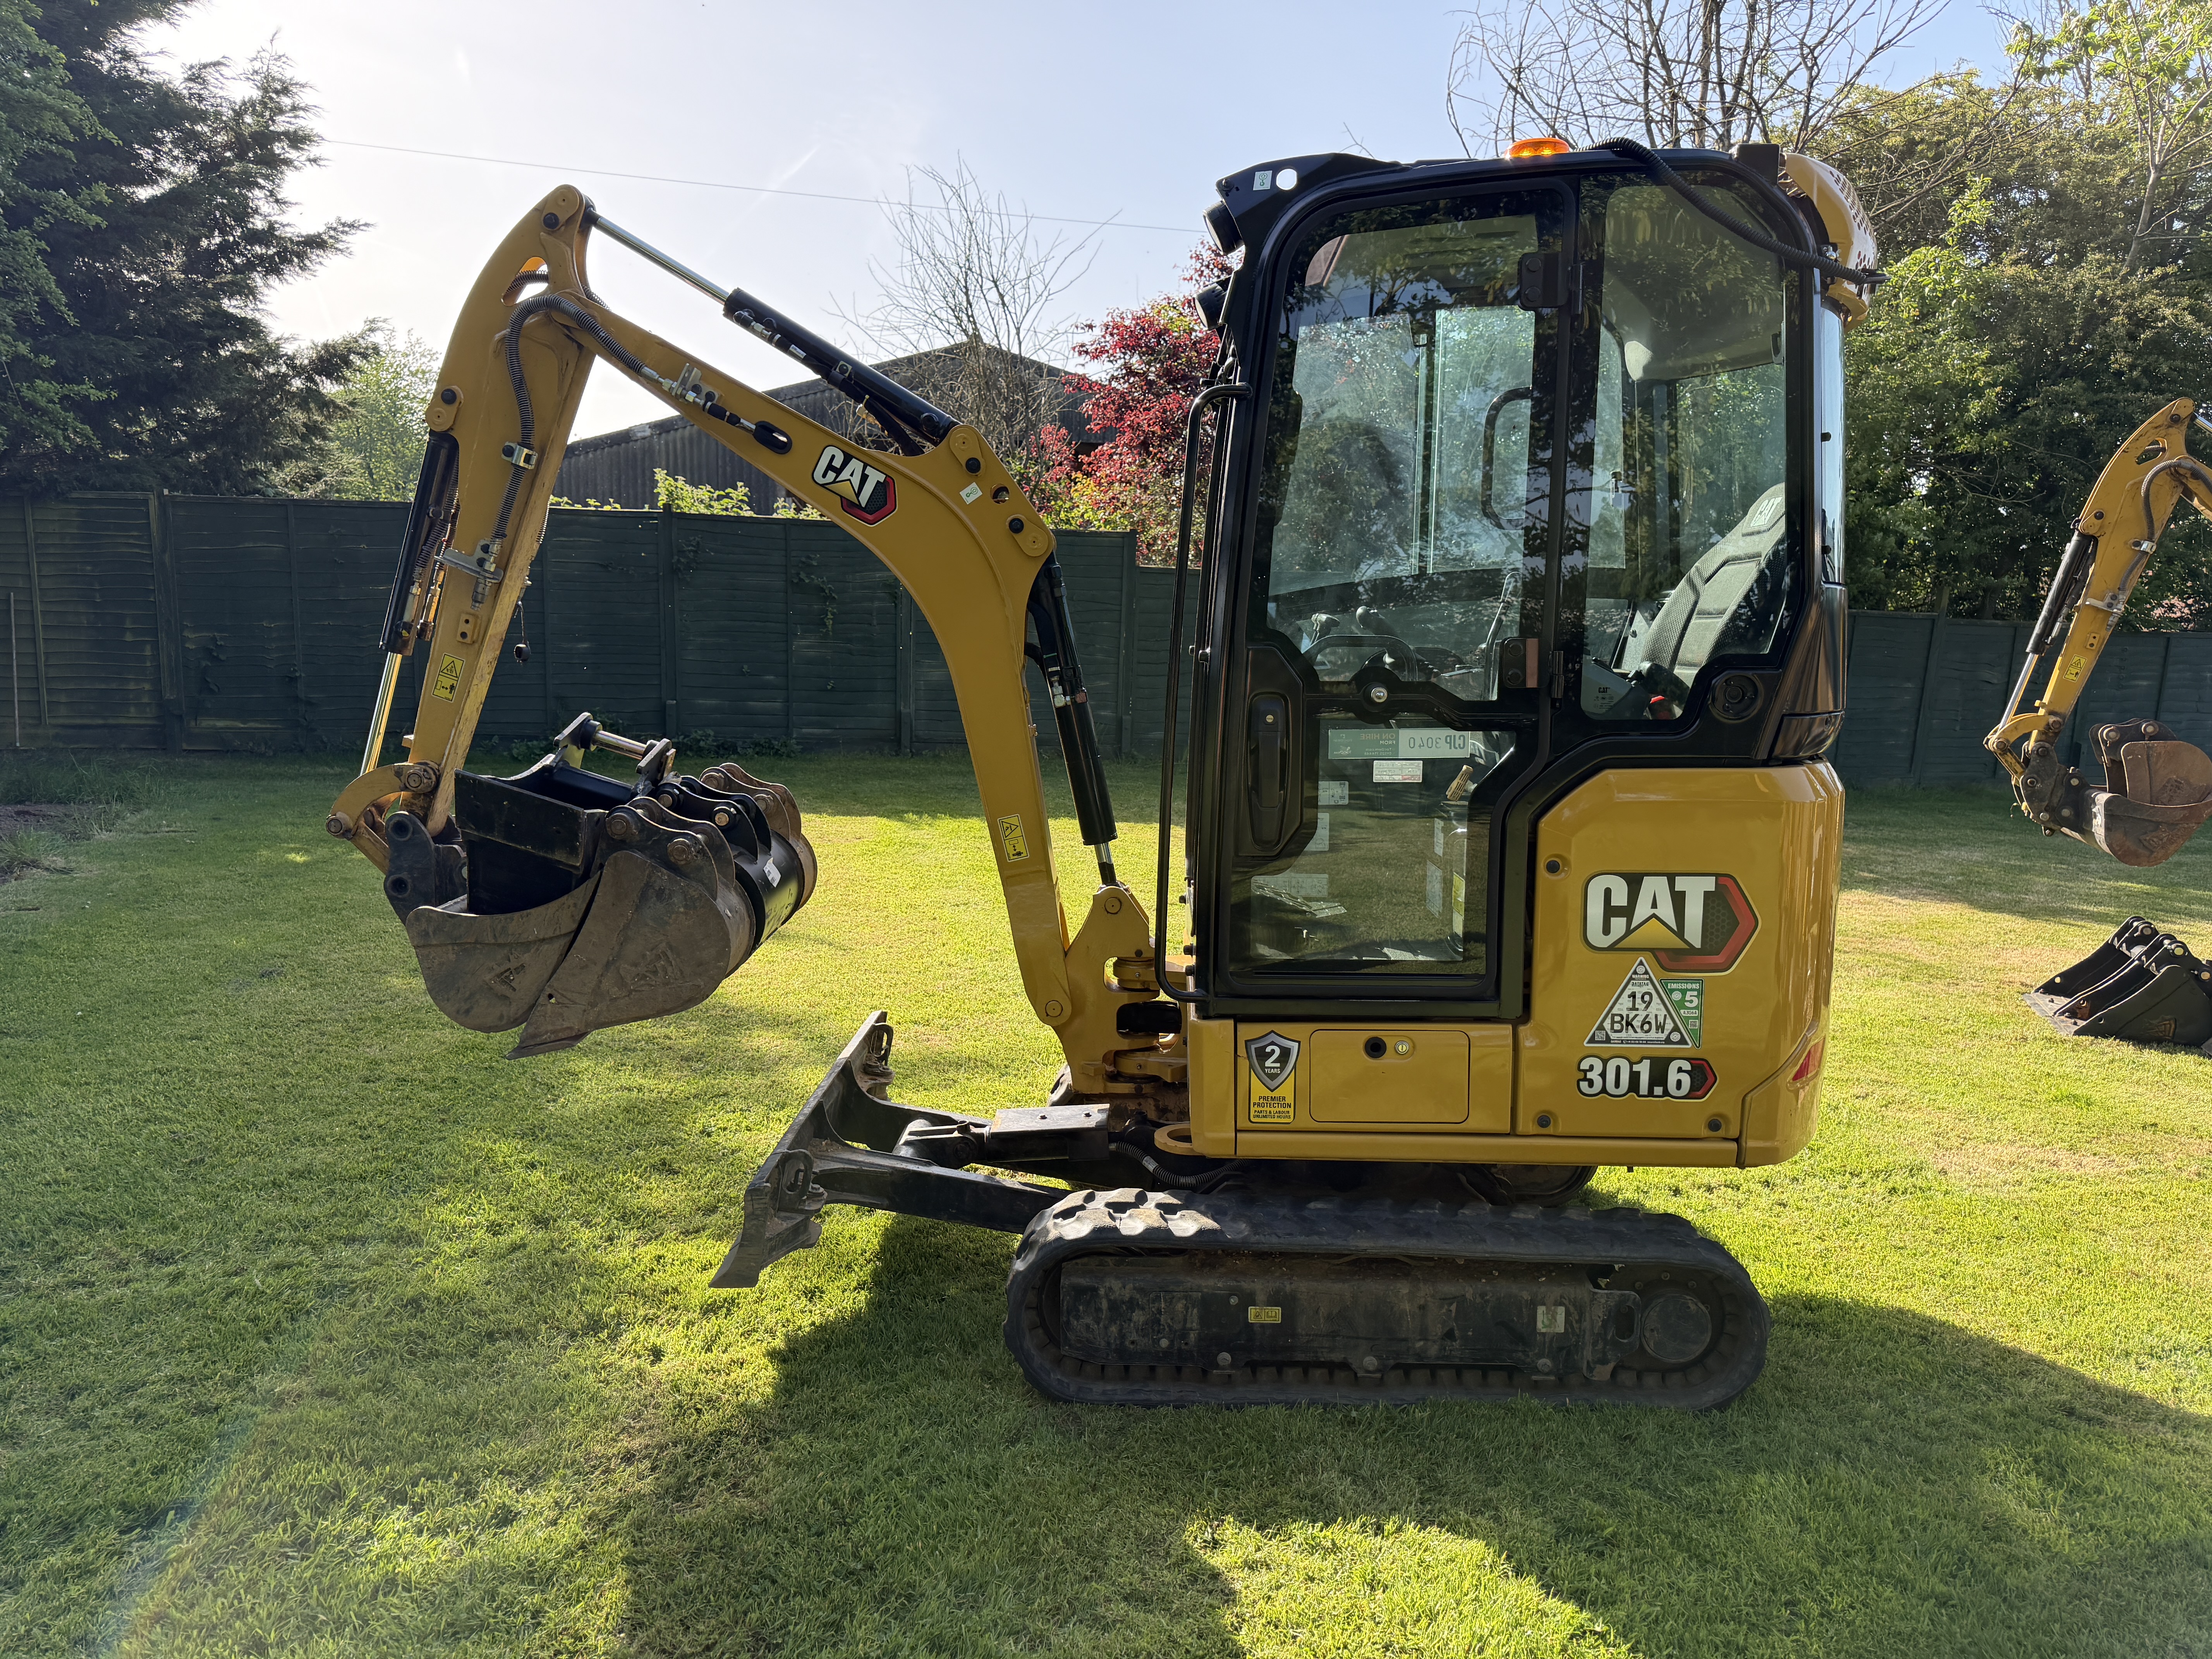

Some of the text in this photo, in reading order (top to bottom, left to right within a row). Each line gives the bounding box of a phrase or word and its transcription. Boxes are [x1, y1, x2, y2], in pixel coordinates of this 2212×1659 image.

[814, 446, 886, 508] CAT
[1587, 874, 1716, 948] CAT
[1626, 991, 1653, 1011] 19
[1684, 991, 1698, 1007] 5
[1610, 1013, 1667, 1034] BK6W
[1265, 1046, 1280, 1067] 2
[1579, 1057, 1692, 1097] 301.6
